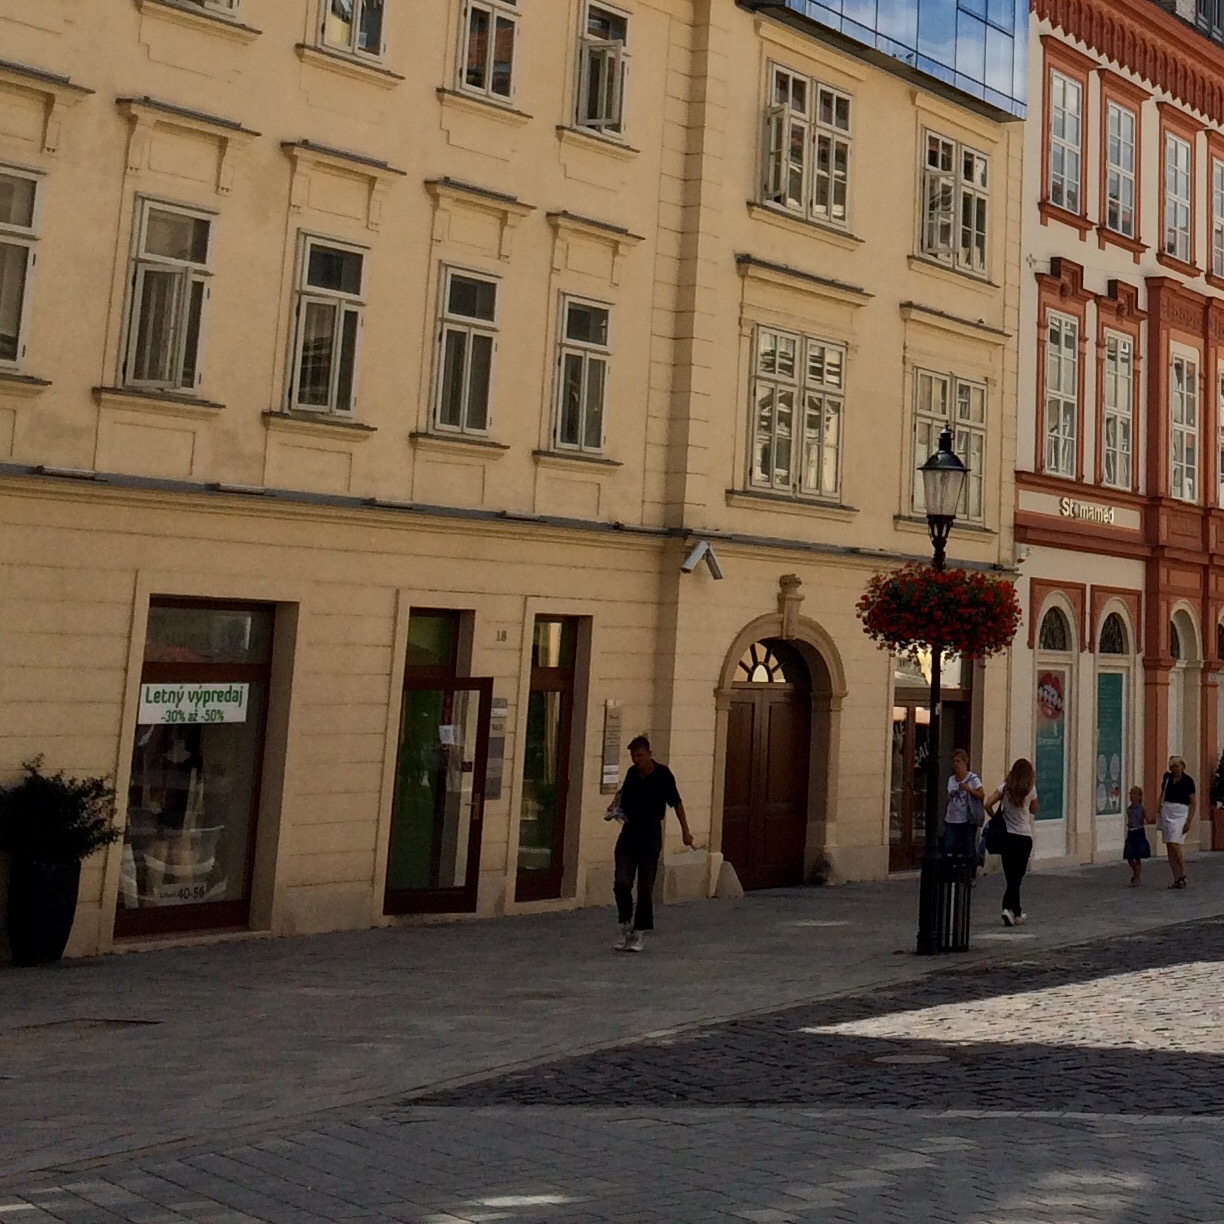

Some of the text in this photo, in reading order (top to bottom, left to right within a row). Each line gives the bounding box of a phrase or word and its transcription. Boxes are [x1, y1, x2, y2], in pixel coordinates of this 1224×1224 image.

[496, 630, 507, 642] 18
[145, 685, 243, 708] Letný výpredaj
[161, 709, 225, 723] -30% až -50%
